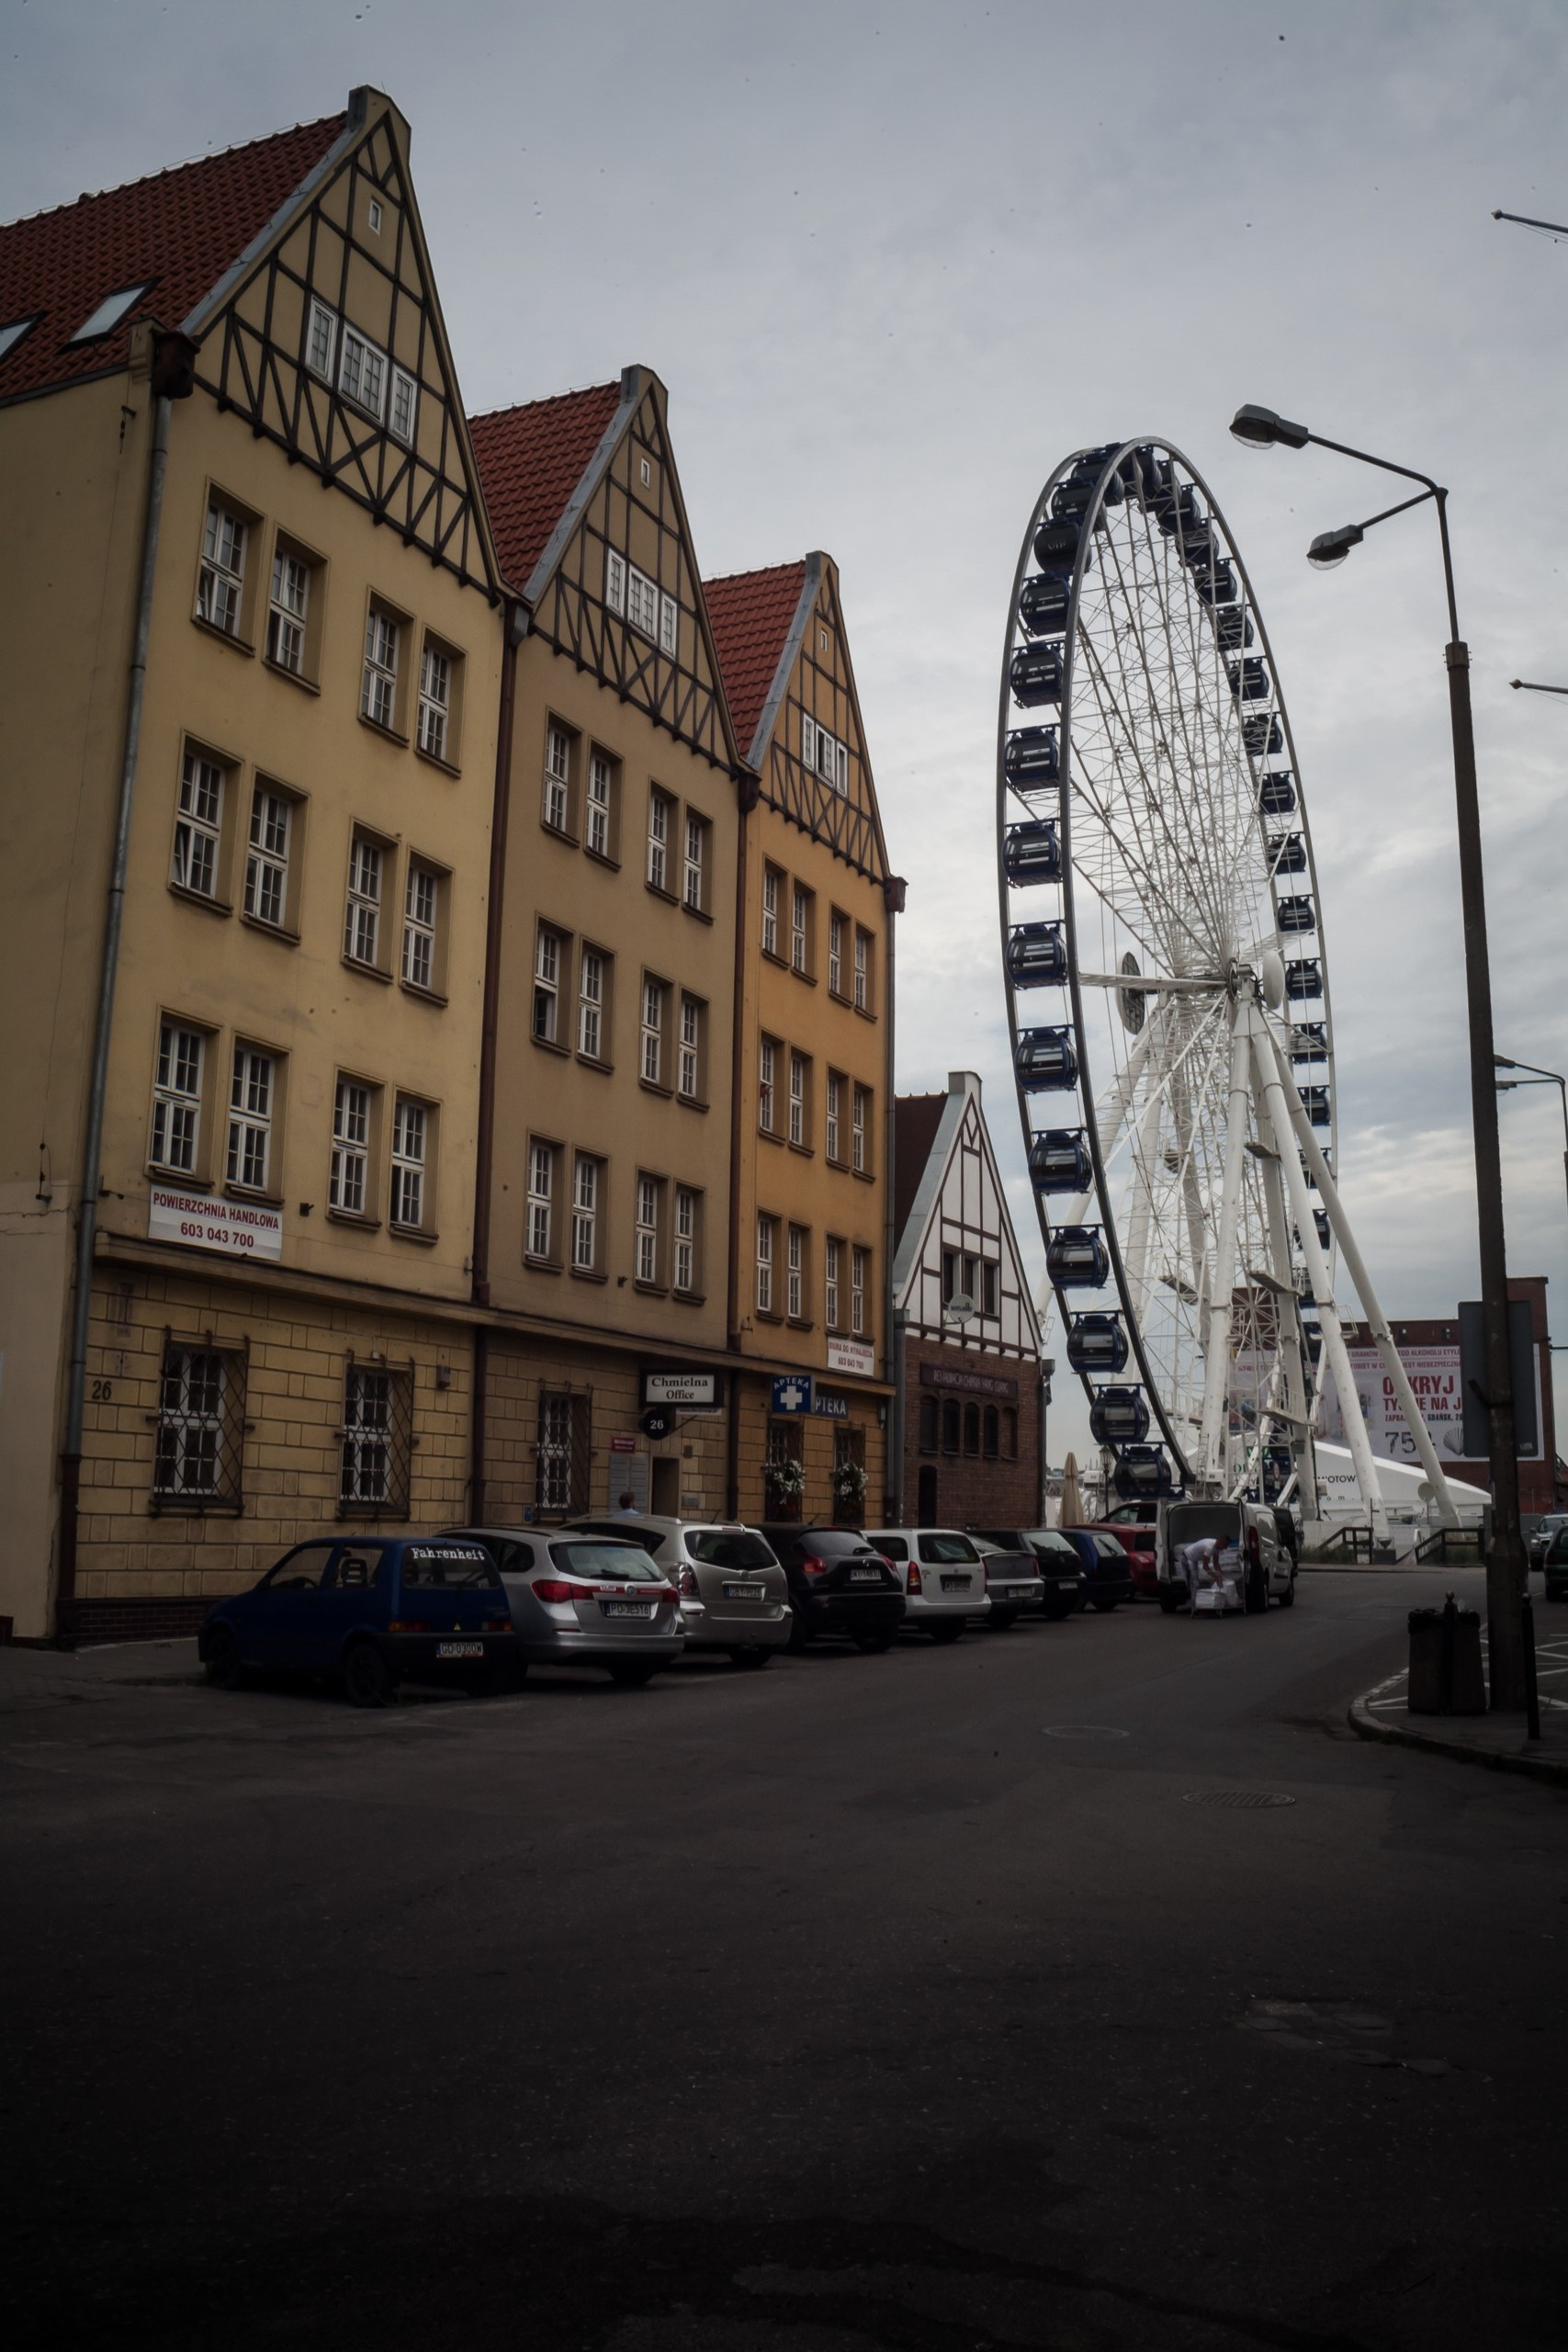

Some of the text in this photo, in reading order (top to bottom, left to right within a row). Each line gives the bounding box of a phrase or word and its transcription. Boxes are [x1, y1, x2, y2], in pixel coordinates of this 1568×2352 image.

[153, 1192, 279, 1229] POWIERZCHNIA HANDLOWA
[180, 1222, 254, 1248] 603 043 700
[651, 1376, 708, 1387] Chmielna
[773, 1376, 809, 1390] APTEKA
[1382, 1375, 1454, 1396] OKRYJ
[91, 1380, 112, 1400] 26
[666, 1389, 694, 1399] Office
[815, 1396, 847, 1416] PTEKA
[1430, 1396, 1449, 1410] NA
[649, 1419, 665, 1430] 26
[411, 1546, 485, 1561] Fahrenheit
[611, 1603, 624, 1614] PO
[441, 1643, 454, 1655] GD
